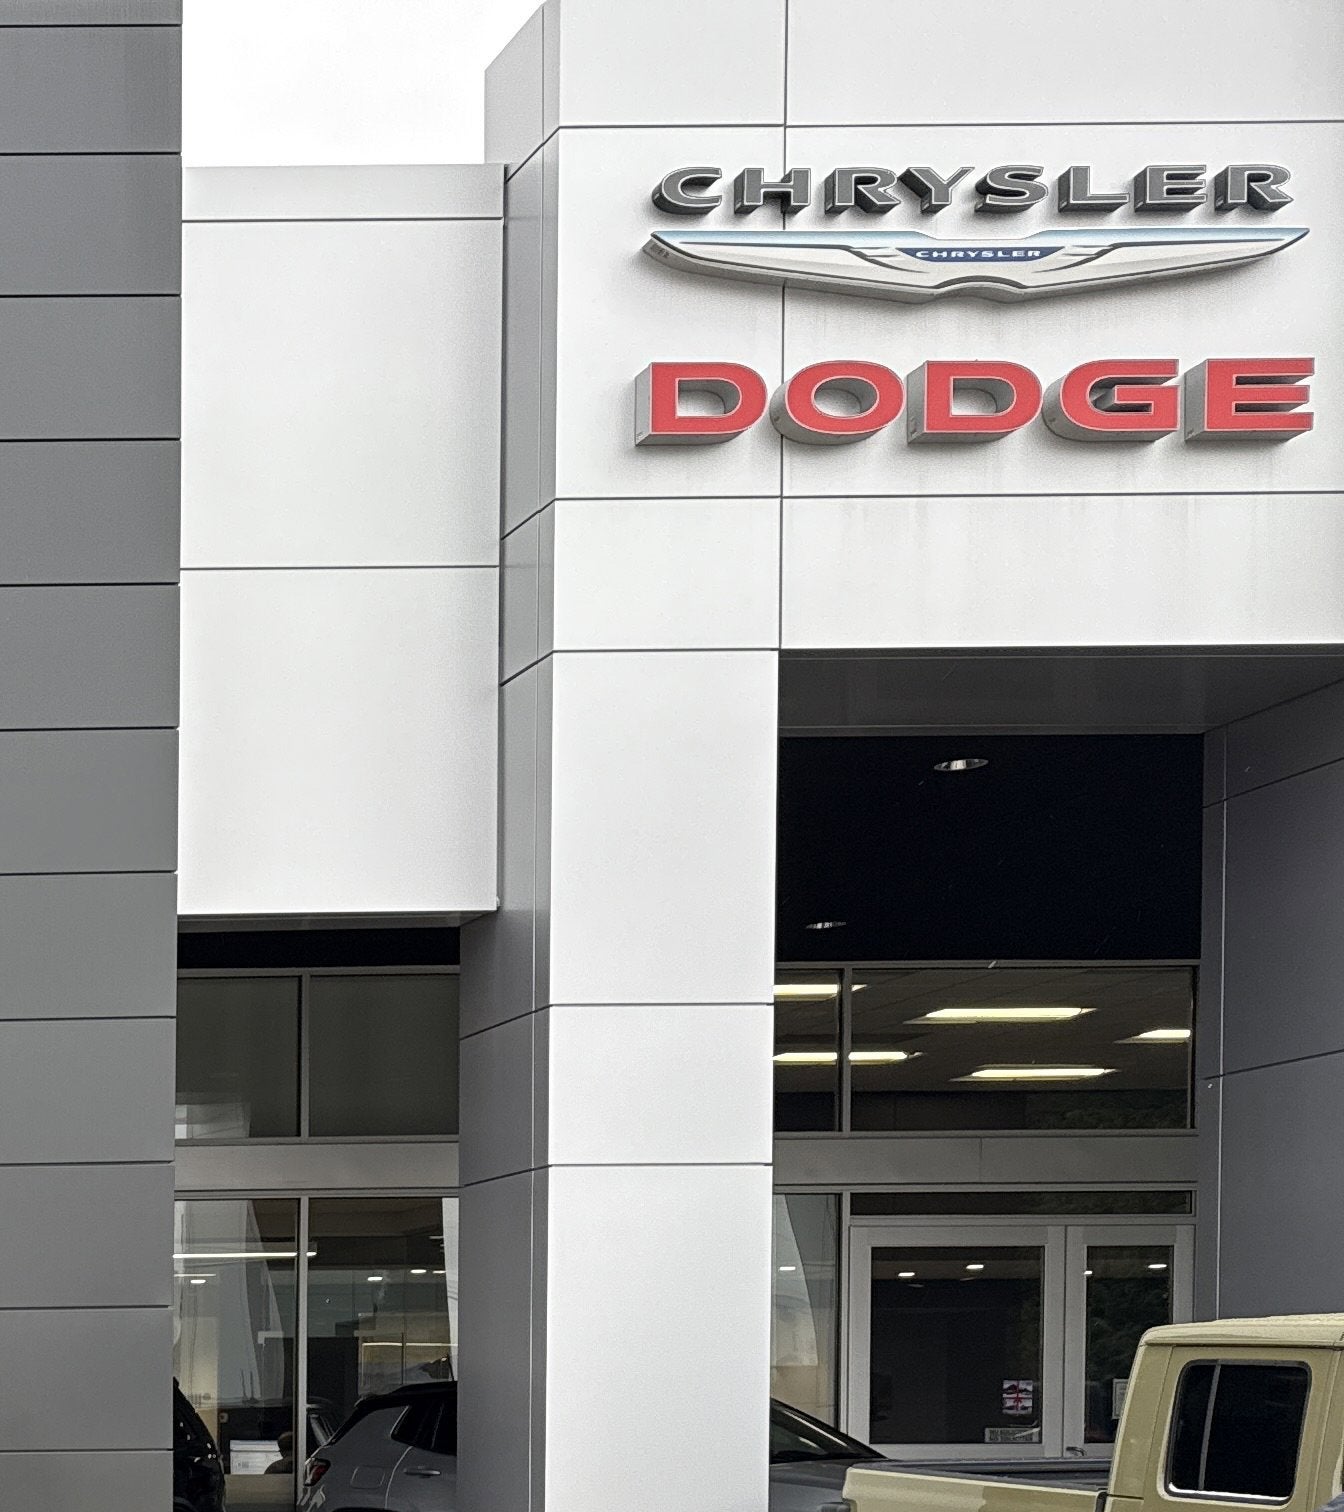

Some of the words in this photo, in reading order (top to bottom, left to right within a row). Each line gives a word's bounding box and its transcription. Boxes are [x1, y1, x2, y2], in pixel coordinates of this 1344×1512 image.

[653, 164, 1294, 216] CHRYSLER
[915, 250, 1041, 258] CHRYSLER
[637, 358, 1315, 445] DODGE
